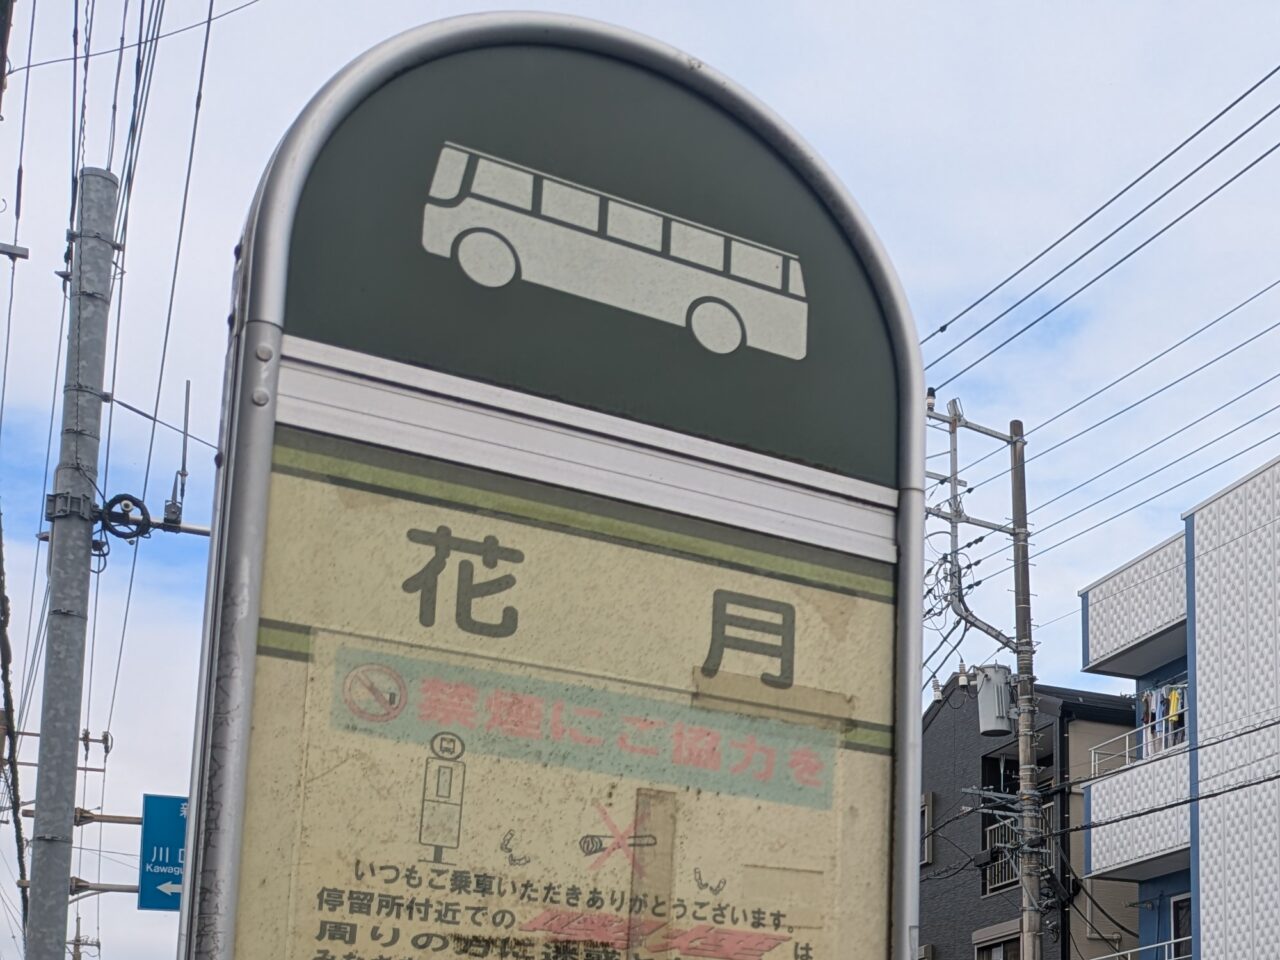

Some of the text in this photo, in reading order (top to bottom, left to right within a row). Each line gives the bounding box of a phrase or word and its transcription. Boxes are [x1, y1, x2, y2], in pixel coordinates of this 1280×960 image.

[417, 677, 826, 788] 禁煙にご協力を
[316, 886, 516, 930] 停留所付近での
[355, 860, 794, 934] いつもご乗車いただきありがとうございます。
